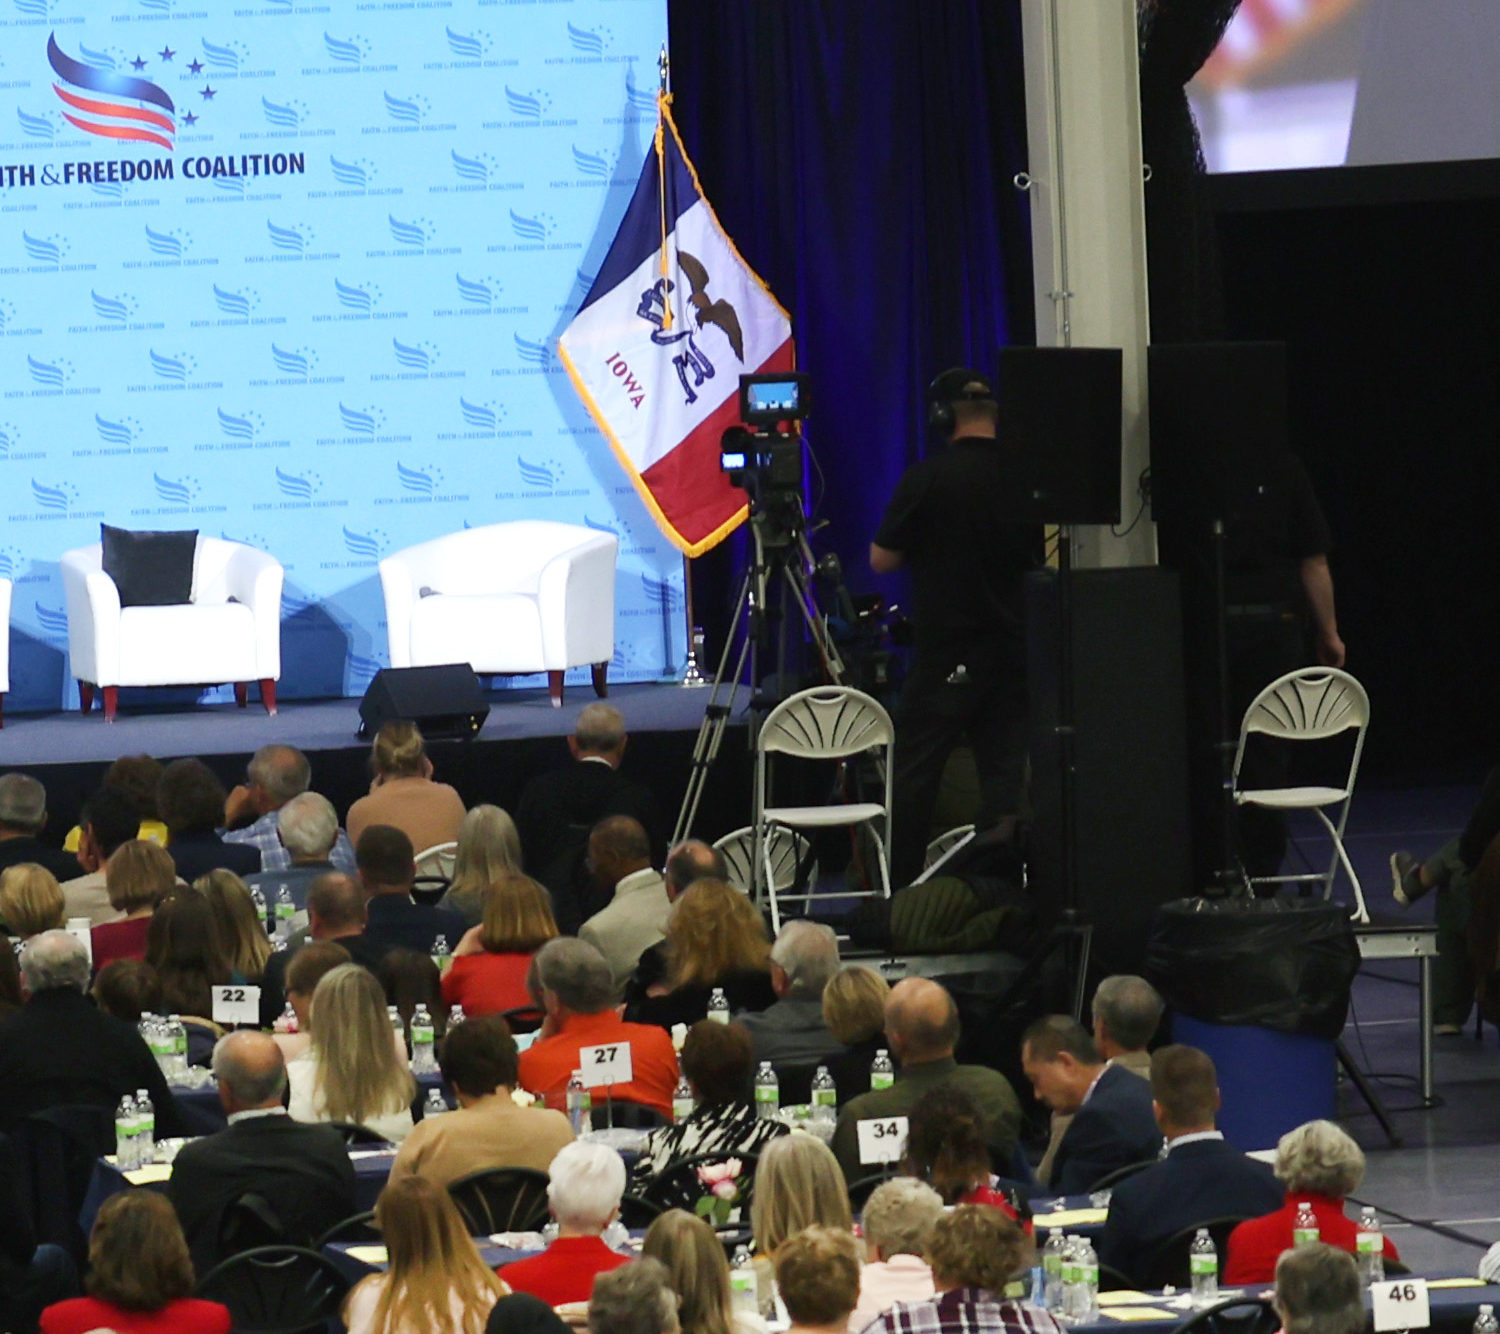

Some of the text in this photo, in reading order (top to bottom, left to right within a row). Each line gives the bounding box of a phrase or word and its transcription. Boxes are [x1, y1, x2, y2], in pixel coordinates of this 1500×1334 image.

[40, 164, 61, 186] &
[63, 158, 174, 185] FREEDOM
[181, 152, 305, 179] COALITION
[605, 352, 646, 410] IOWA
[222, 989, 245, 1002] 22
[595, 1047, 618, 1063] 27
[873, 1123, 898, 1138] 34
[1390, 1285, 1416, 1302] 46
